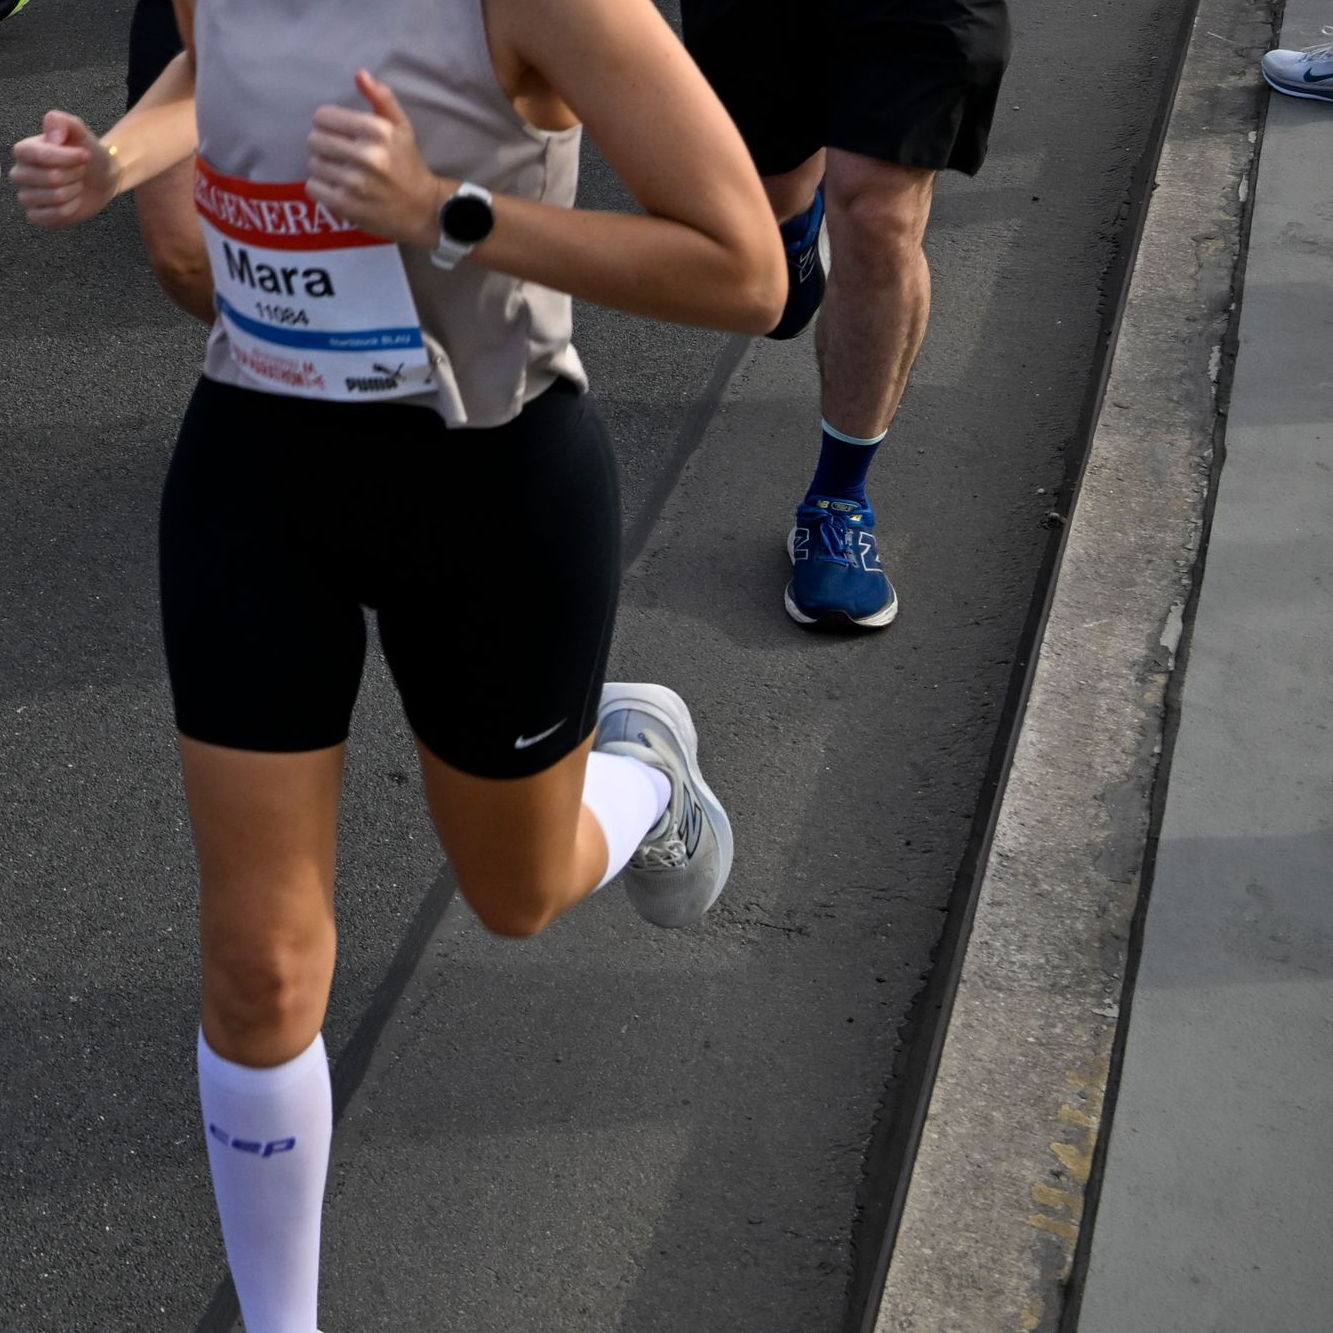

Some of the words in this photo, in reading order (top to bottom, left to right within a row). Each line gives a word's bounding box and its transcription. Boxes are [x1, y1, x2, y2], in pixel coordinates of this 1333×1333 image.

[209, 184, 359, 237] GENERA
[222, 241, 336, 299] Mara
[254, 301, 310, 328] 11084
